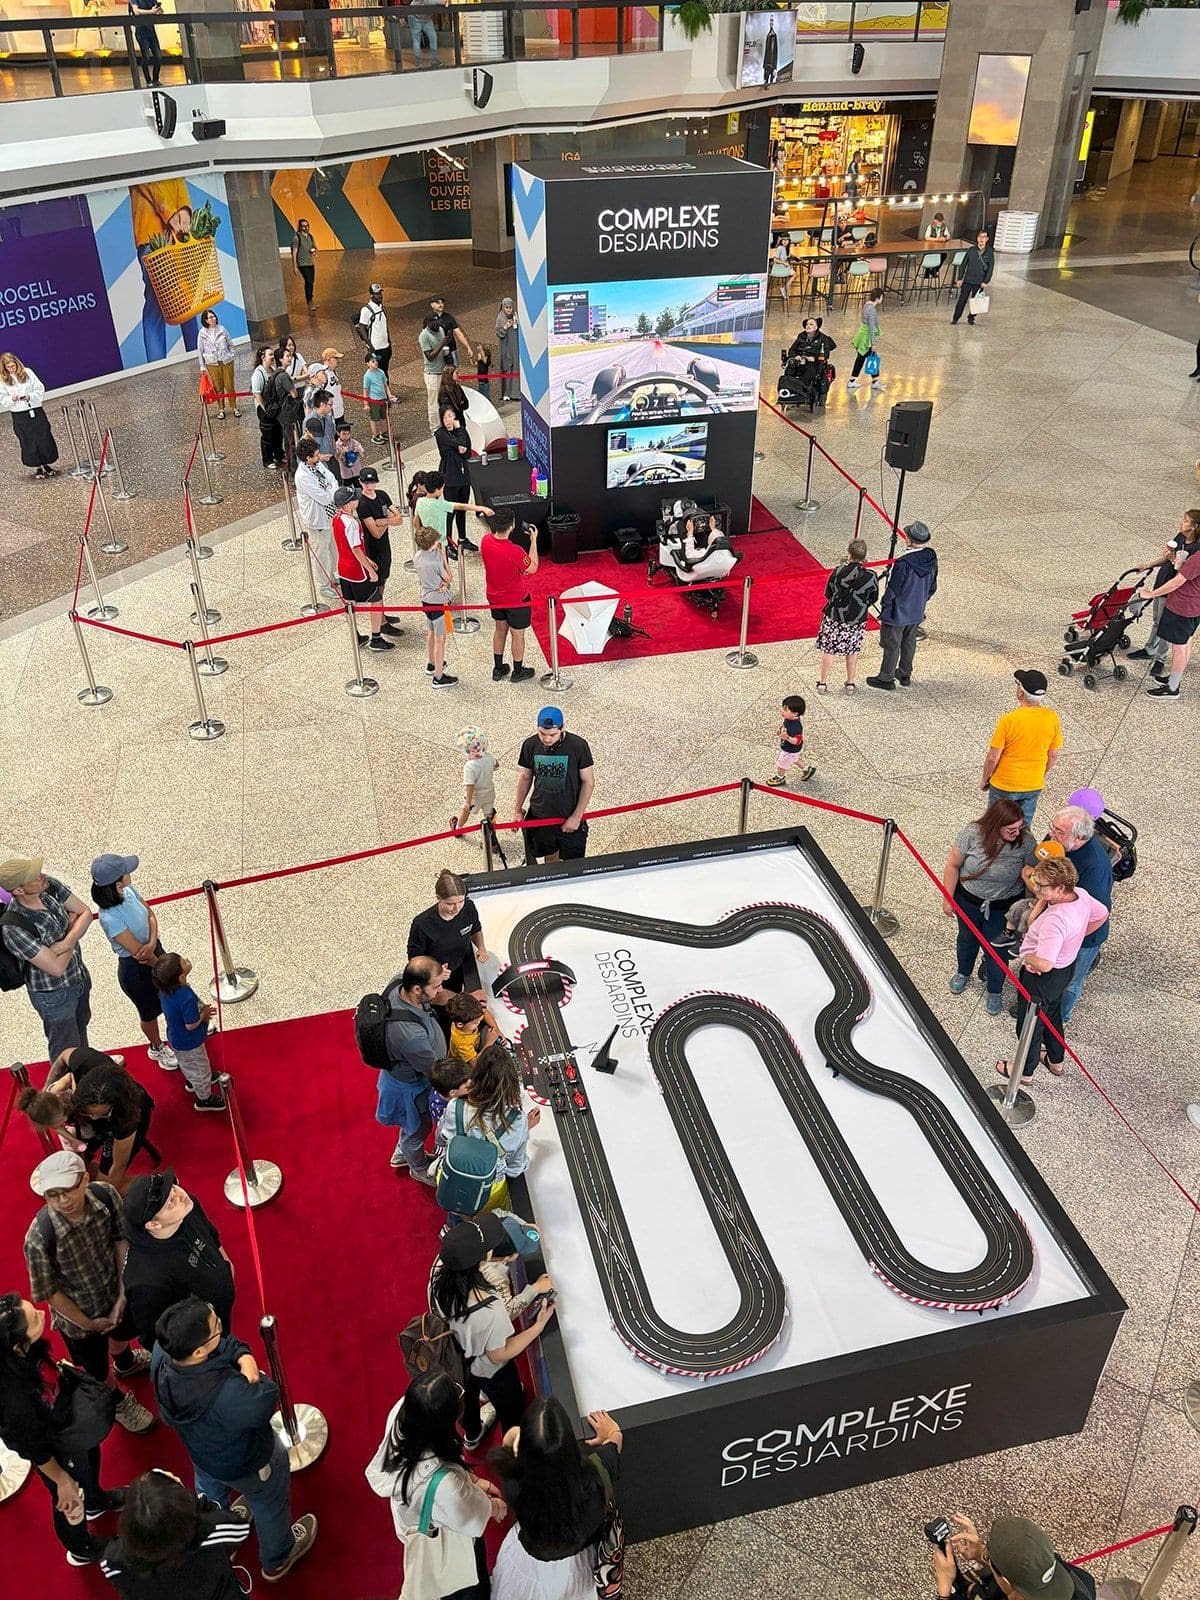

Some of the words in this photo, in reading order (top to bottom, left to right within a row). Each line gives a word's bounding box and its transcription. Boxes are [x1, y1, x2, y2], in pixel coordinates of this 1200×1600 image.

[429, 185, 471, 197] OUVER
[430, 199, 451, 211] LES
[453, 196, 472, 210] RÉ
[598, 204, 720, 231] COMPLEXE
[599, 228, 719, 253] DESJARDINS
[28, 292, 97, 322] DESPARS
[595, 951, 639, 1038] DESJARDINS
[721, 1383, 972, 1462] COMPLEXE
[721, 1410, 964, 1487] DESJARDINS
